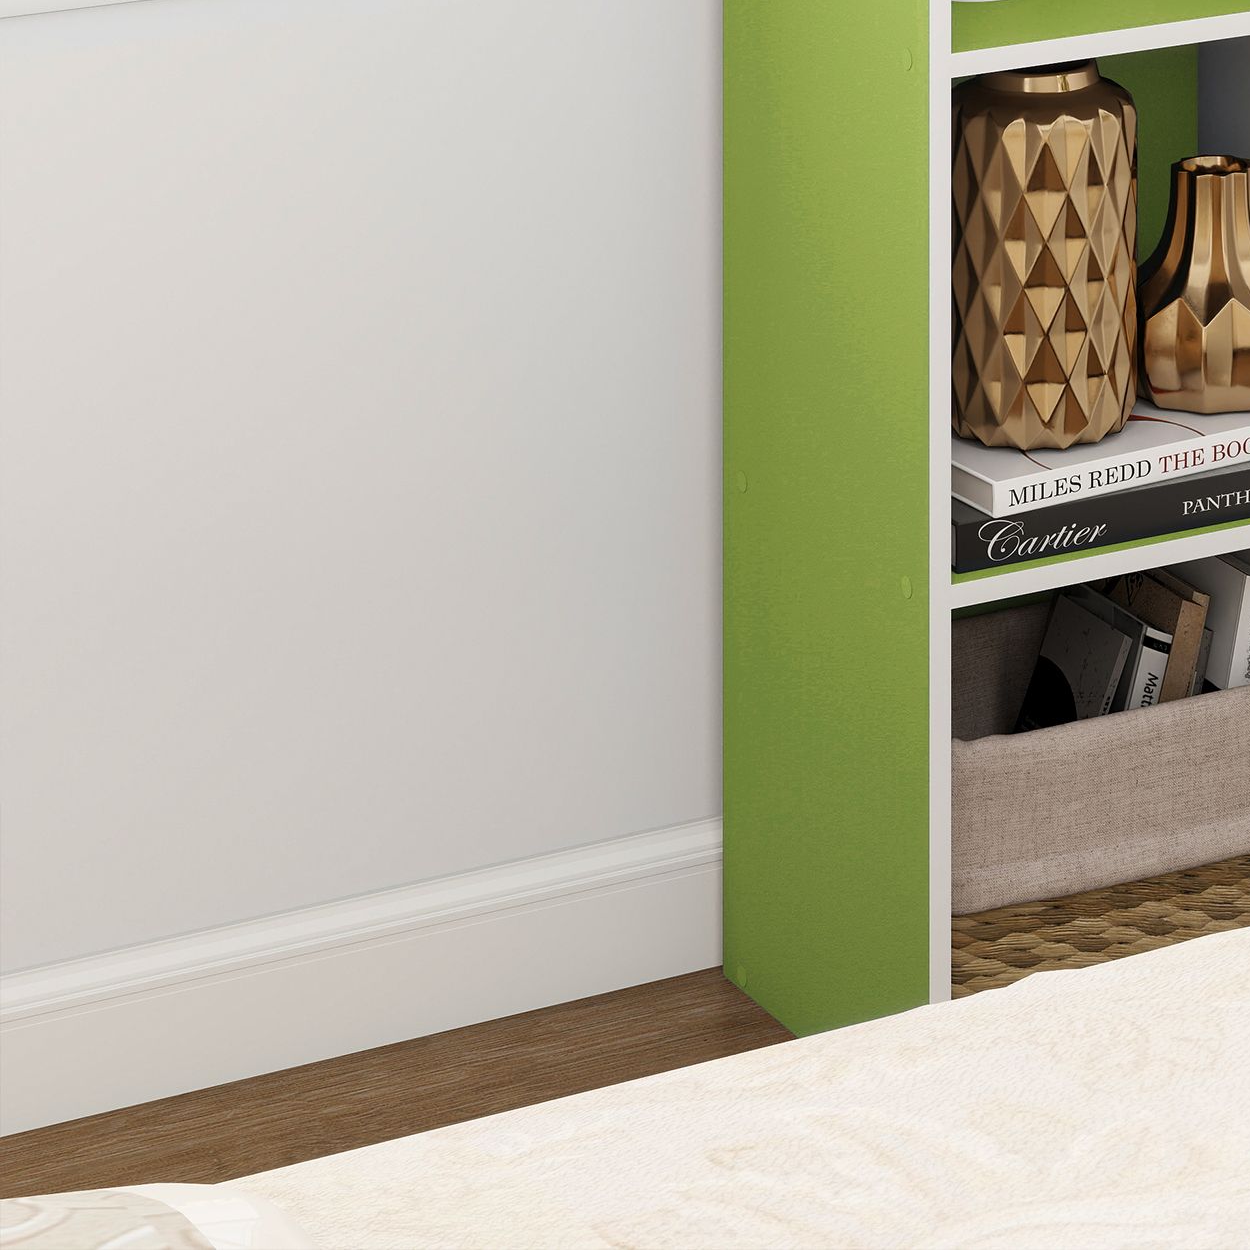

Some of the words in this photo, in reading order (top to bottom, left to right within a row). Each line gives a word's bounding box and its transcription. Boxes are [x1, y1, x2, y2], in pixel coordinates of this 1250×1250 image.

[1008, 474, 1082, 507] MILES
[1088, 459, 1152, 490] REDD
[1158, 448, 1206, 474] THE
[978, 519, 1108, 561] Cartier
